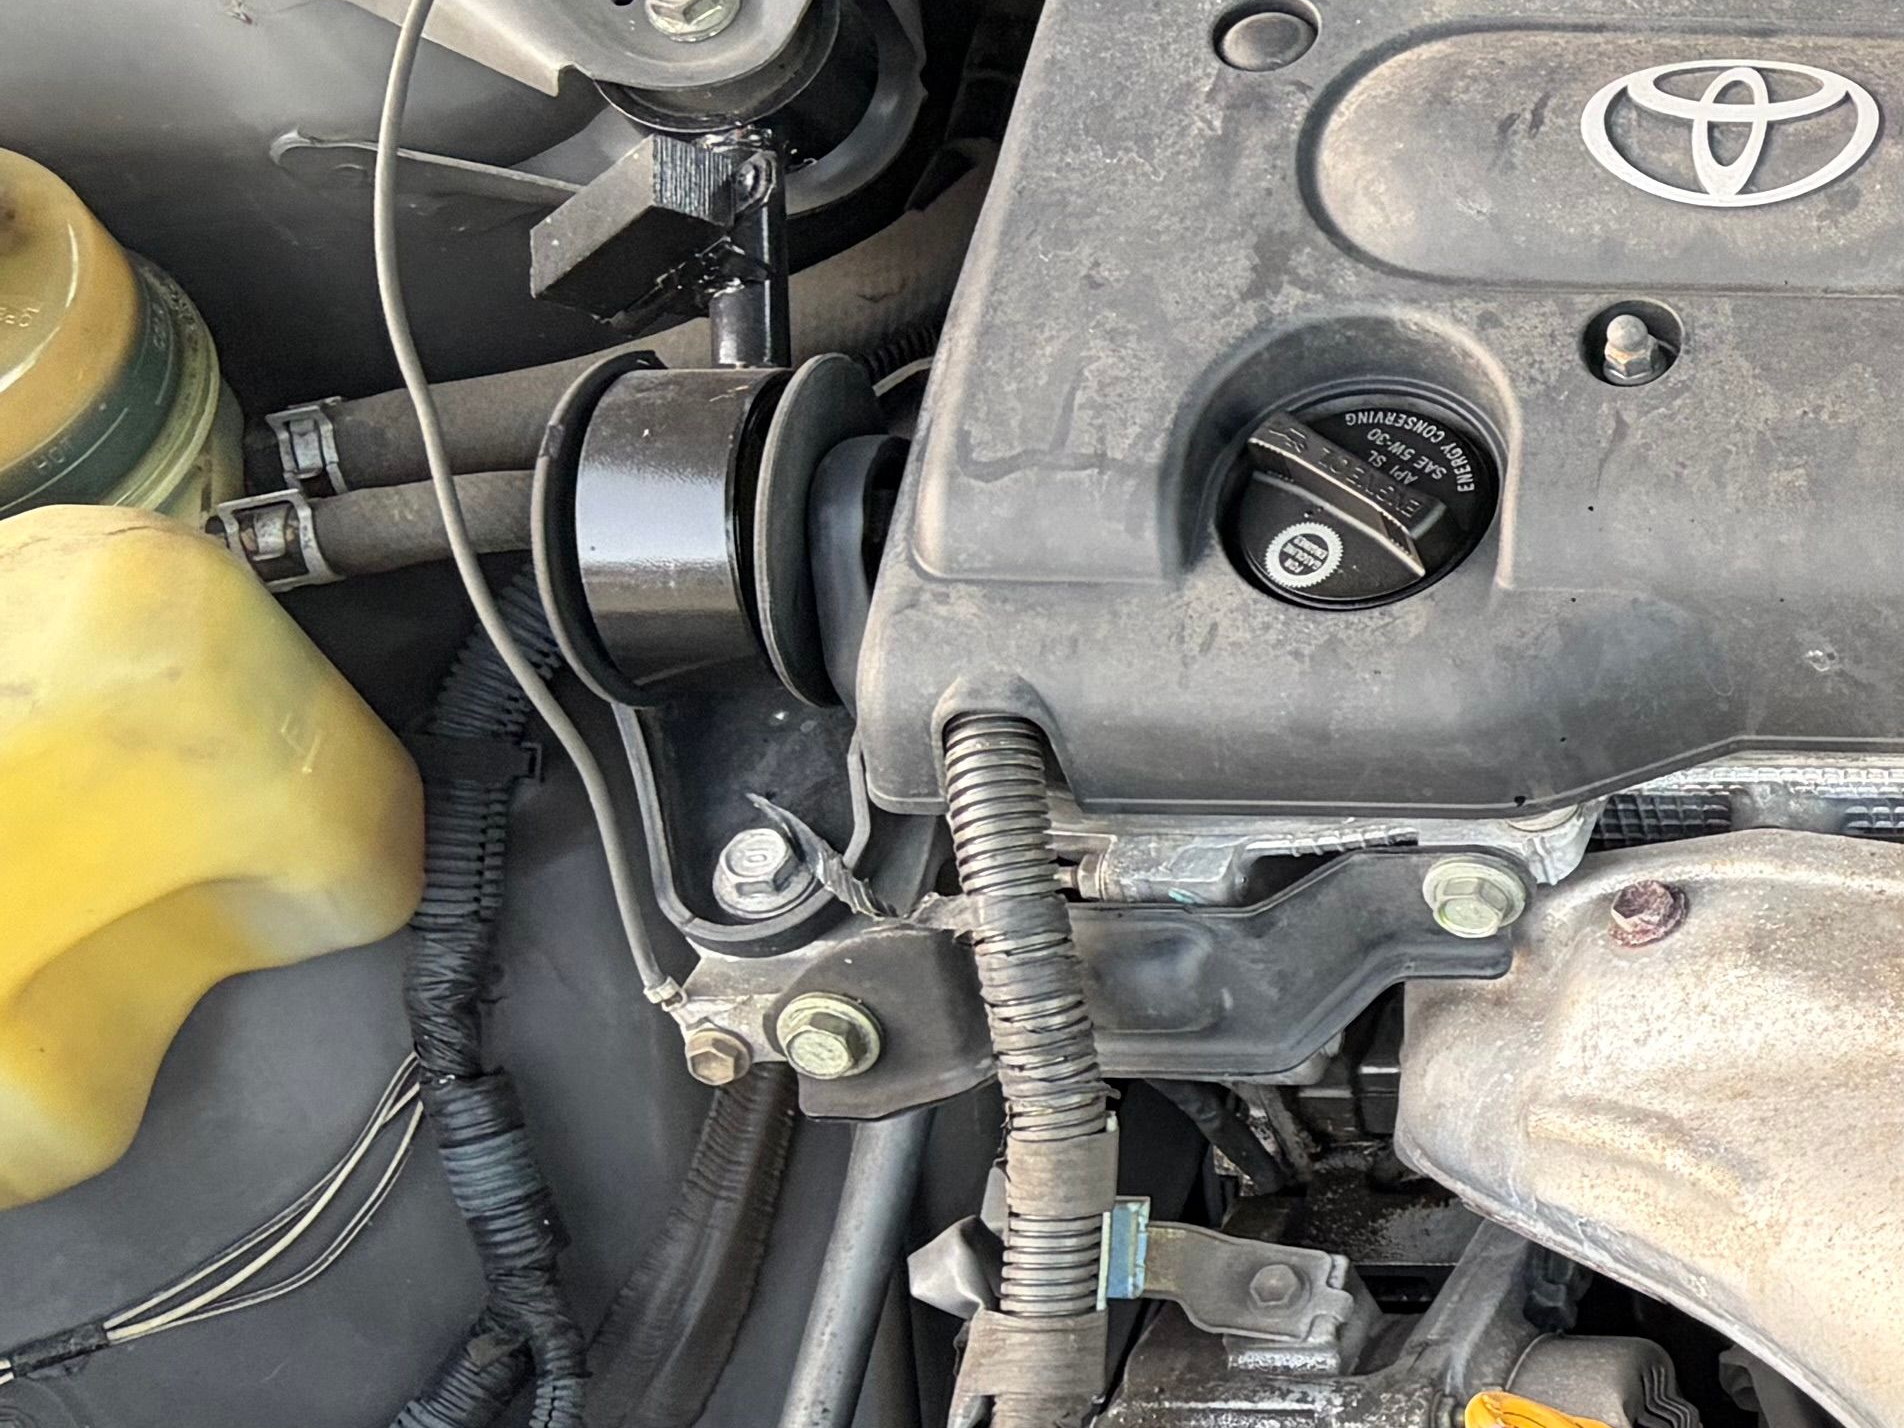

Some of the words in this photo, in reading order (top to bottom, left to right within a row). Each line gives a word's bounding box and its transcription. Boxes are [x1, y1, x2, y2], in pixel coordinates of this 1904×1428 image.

[1344, 410, 1445, 443] CONSERVING
[1366, 426, 1415, 461] 5W-30
[1367, 448, 1386, 466] SL
[1386, 464, 1418, 485] API
[1414, 454, 1447, 480] SAE
[1439, 435, 1475, 492] ENERGY
